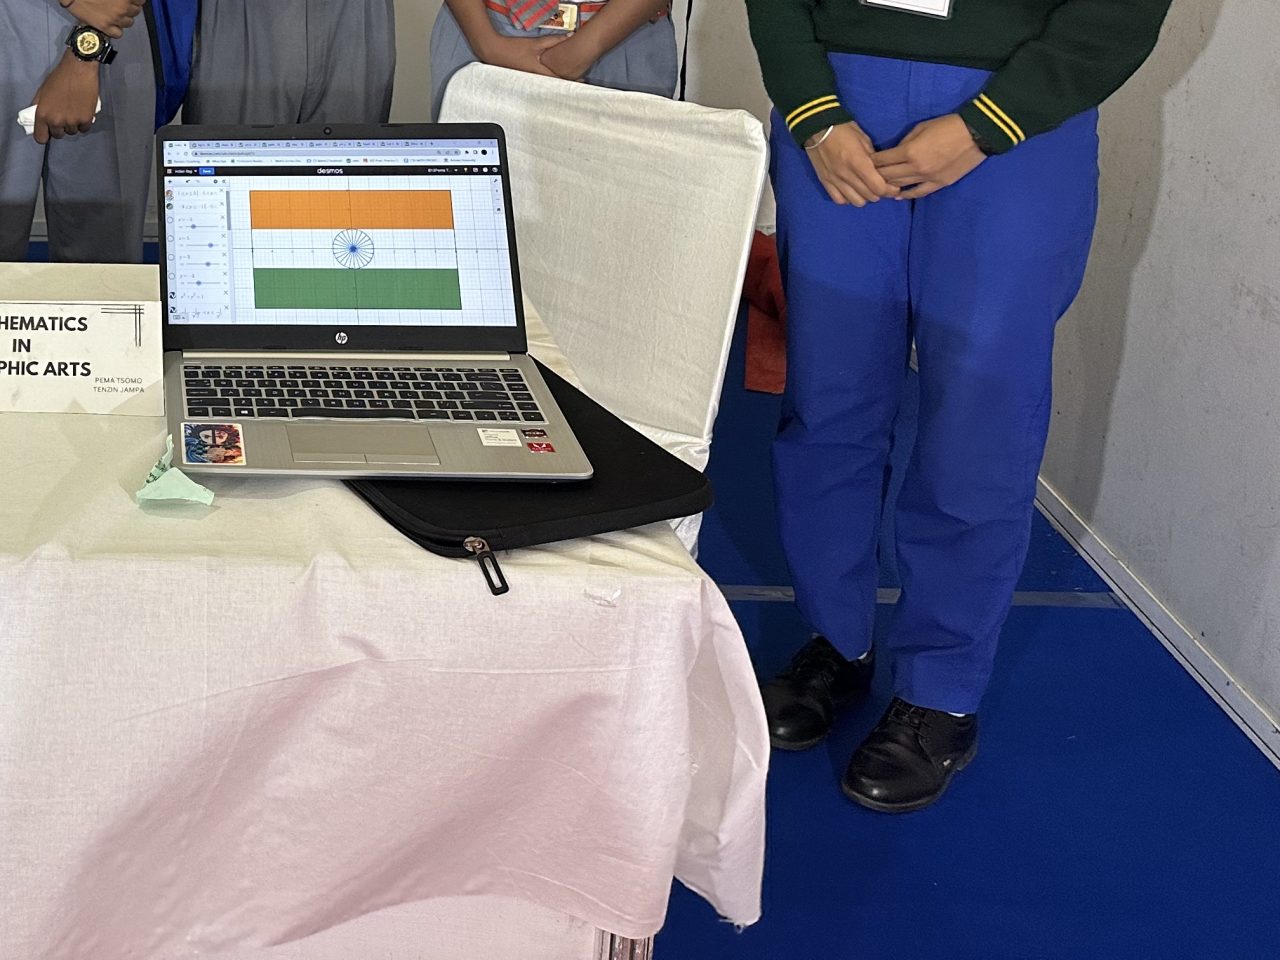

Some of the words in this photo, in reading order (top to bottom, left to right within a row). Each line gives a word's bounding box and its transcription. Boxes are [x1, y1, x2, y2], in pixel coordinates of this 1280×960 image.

[317, 167, 344, 175] desmos
[12, 338, 31, 353] IN
[336, 332, 348, 345] hp
[43, 361, 91, 377] ARTS
